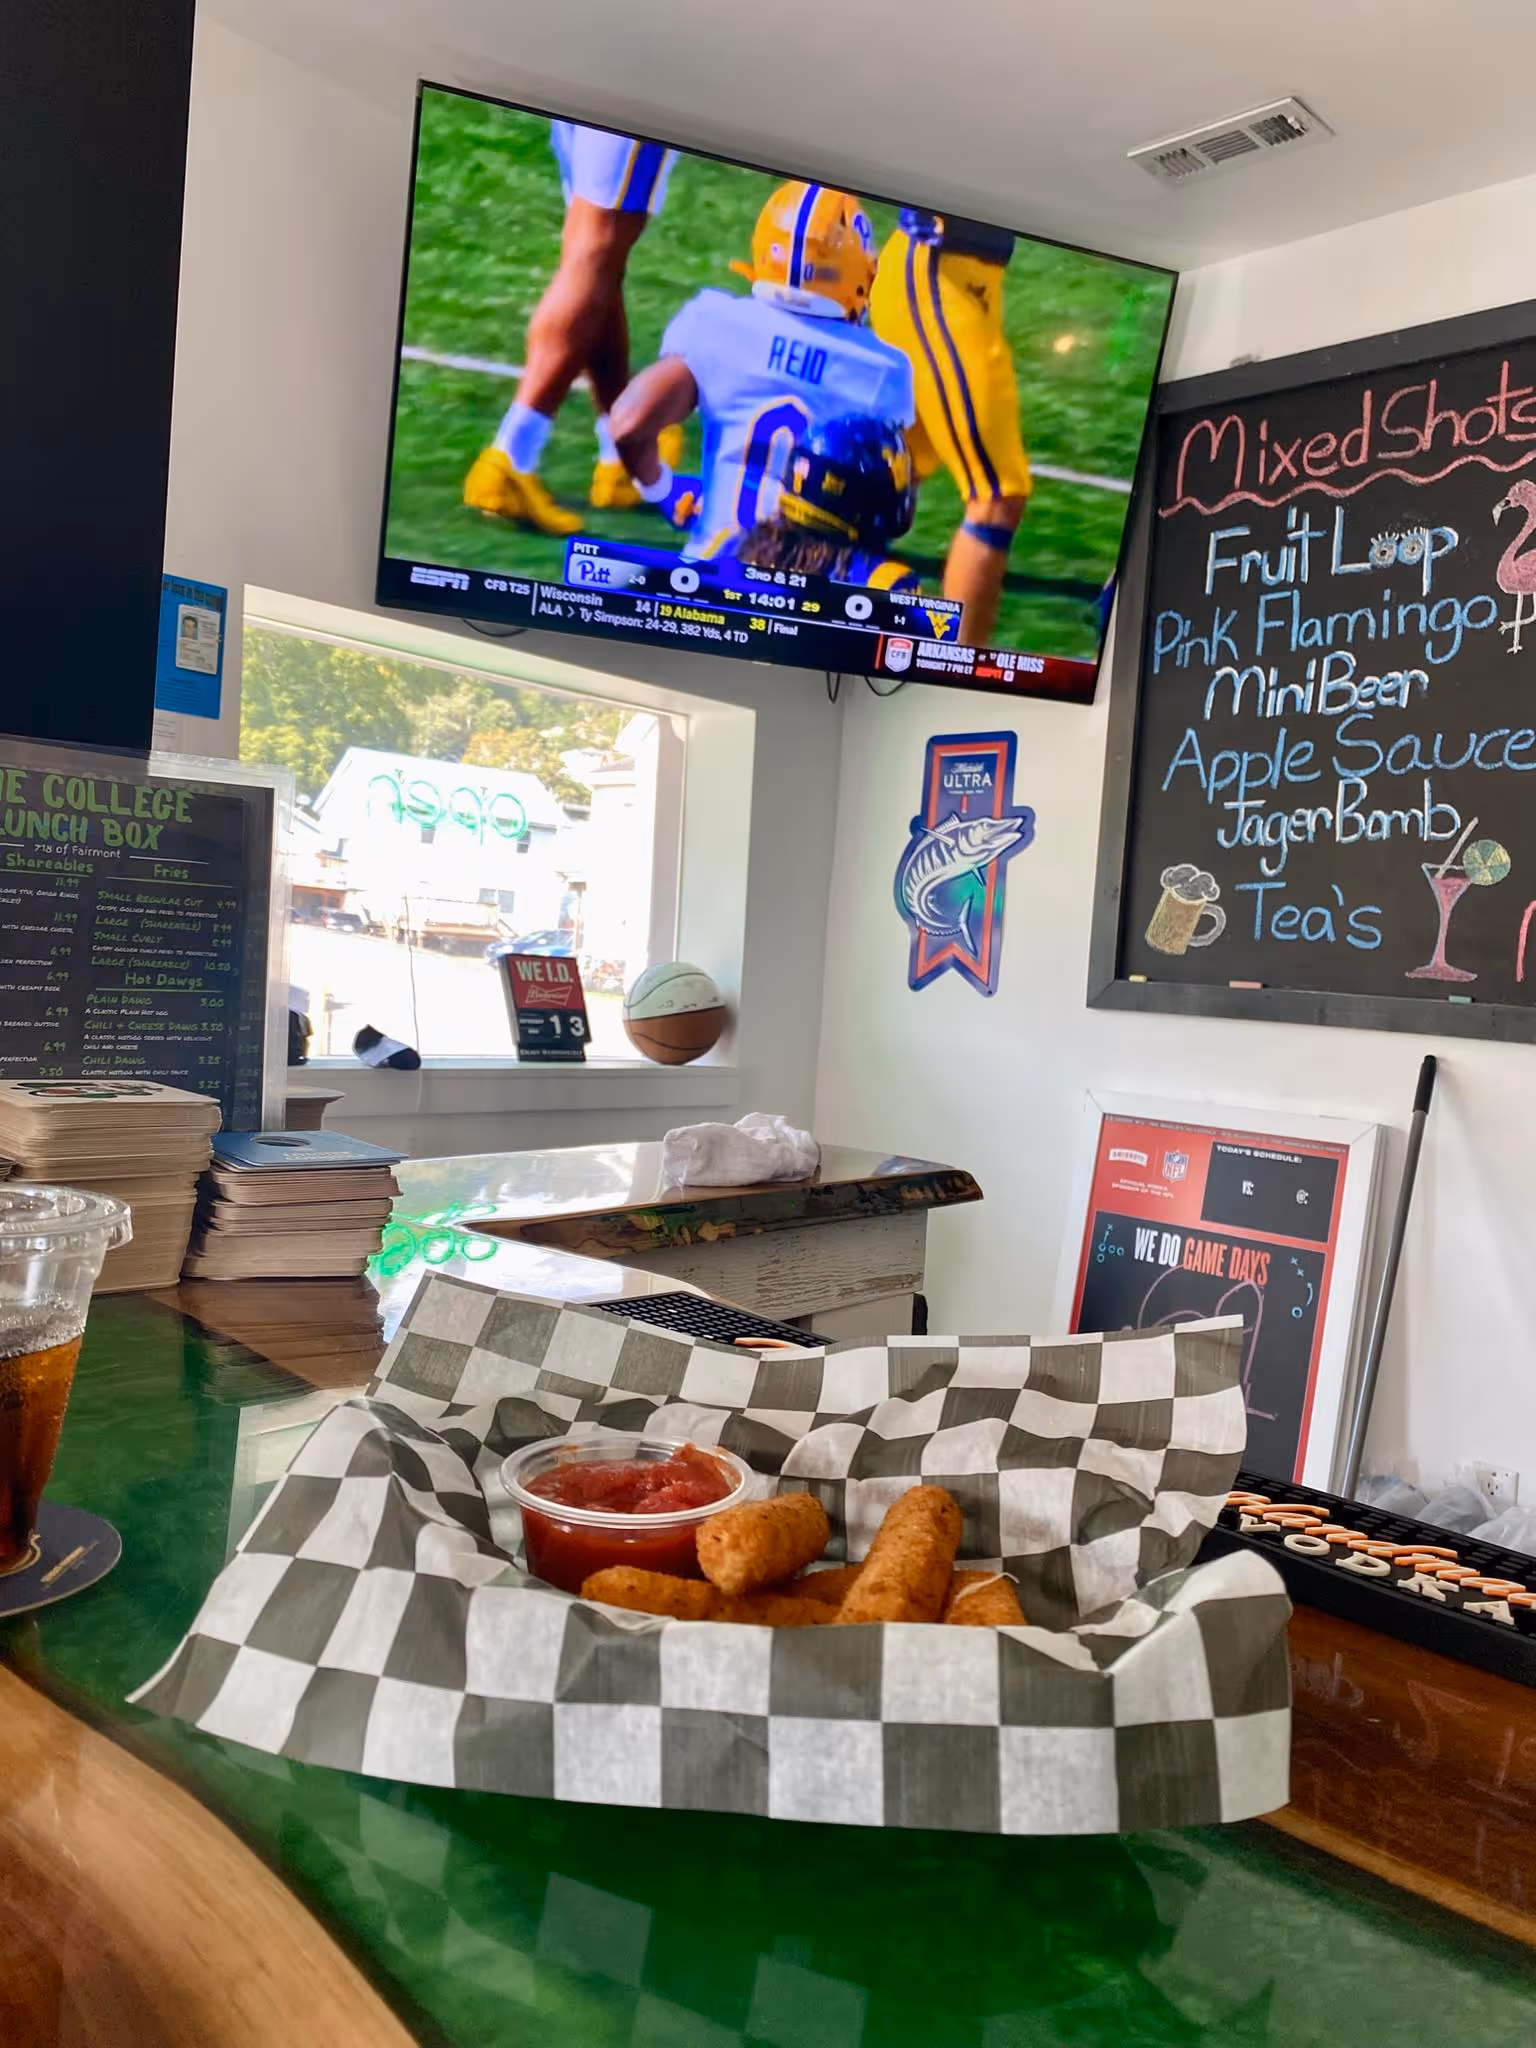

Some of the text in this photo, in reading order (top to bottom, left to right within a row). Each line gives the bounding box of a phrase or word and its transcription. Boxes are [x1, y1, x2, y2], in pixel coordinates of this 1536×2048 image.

[1177, 360, 1536, 499] Mixed Shots
[573, 542, 599, 555] PITT
[1205, 505, 1460, 597] Fruit Loop
[410, 566, 470, 590] ESPN
[577, 560, 611, 584] Pitt
[670, 567, 700, 593] 0
[773, 571, 786, 585] &
[788, 574, 807, 588] 21
[484, 578, 530, 595] CFB T25
[540, 585, 799, 636] Wisconsin 14 19 Alabama 38 Final
[723, 588, 820, 613] 1ST 14:01 29
[844, 594, 873, 620] 0
[890, 592, 960, 613] WEST VIRGINIA
[539, 603, 563, 617] ALA
[580, 608, 593, 622] Ty
[594, 610, 644, 629] Simpson:
[680, 622, 701, 637] 382
[724, 630, 732, 641] 4
[733, 631, 749, 643] TD
[1255, 589, 1498, 666] Flamingo
[917, 641, 976, 664] ARKANSAS
[996, 654, 1017, 670] OLE
[1017, 656, 1045, 673] MISS
[1162, 712, 1536, 804] Apple Sauce
[944, 772, 993, 788] ULTRA
[43, 774, 194, 824] COLLEGE
[101, 818, 164, 851] BOX
[72, 846, 121, 859] Fairmont
[6, 853, 189, 880] Shareables Fries
[97, 890, 132, 902] SMALL
[95, 916, 129, 927] LARGE
[1235, 881, 1382, 950] Tea's
[93, 931, 128, 942] SMALL
[92, 956, 126, 967] LARGE
[515, 960, 574, 983] WE I.D.
[125, 972, 203, 990] Hot Dawgs
[86, 994, 118, 1005] PLAIN
[121, 995, 153, 1005] DAWG
[84, 1020, 112, 1030] CHILI
[128, 1020, 166, 1031] CHEESE
[168, 1021, 198, 1032] DAWG
[82, 1056, 111, 1066] CHILI
[115, 1056, 146, 1065] DAWG
[1216, 1145, 1253, 1157] TODAY'S
[1134, 1226, 1271, 1287] WE DO GAME DAYS
